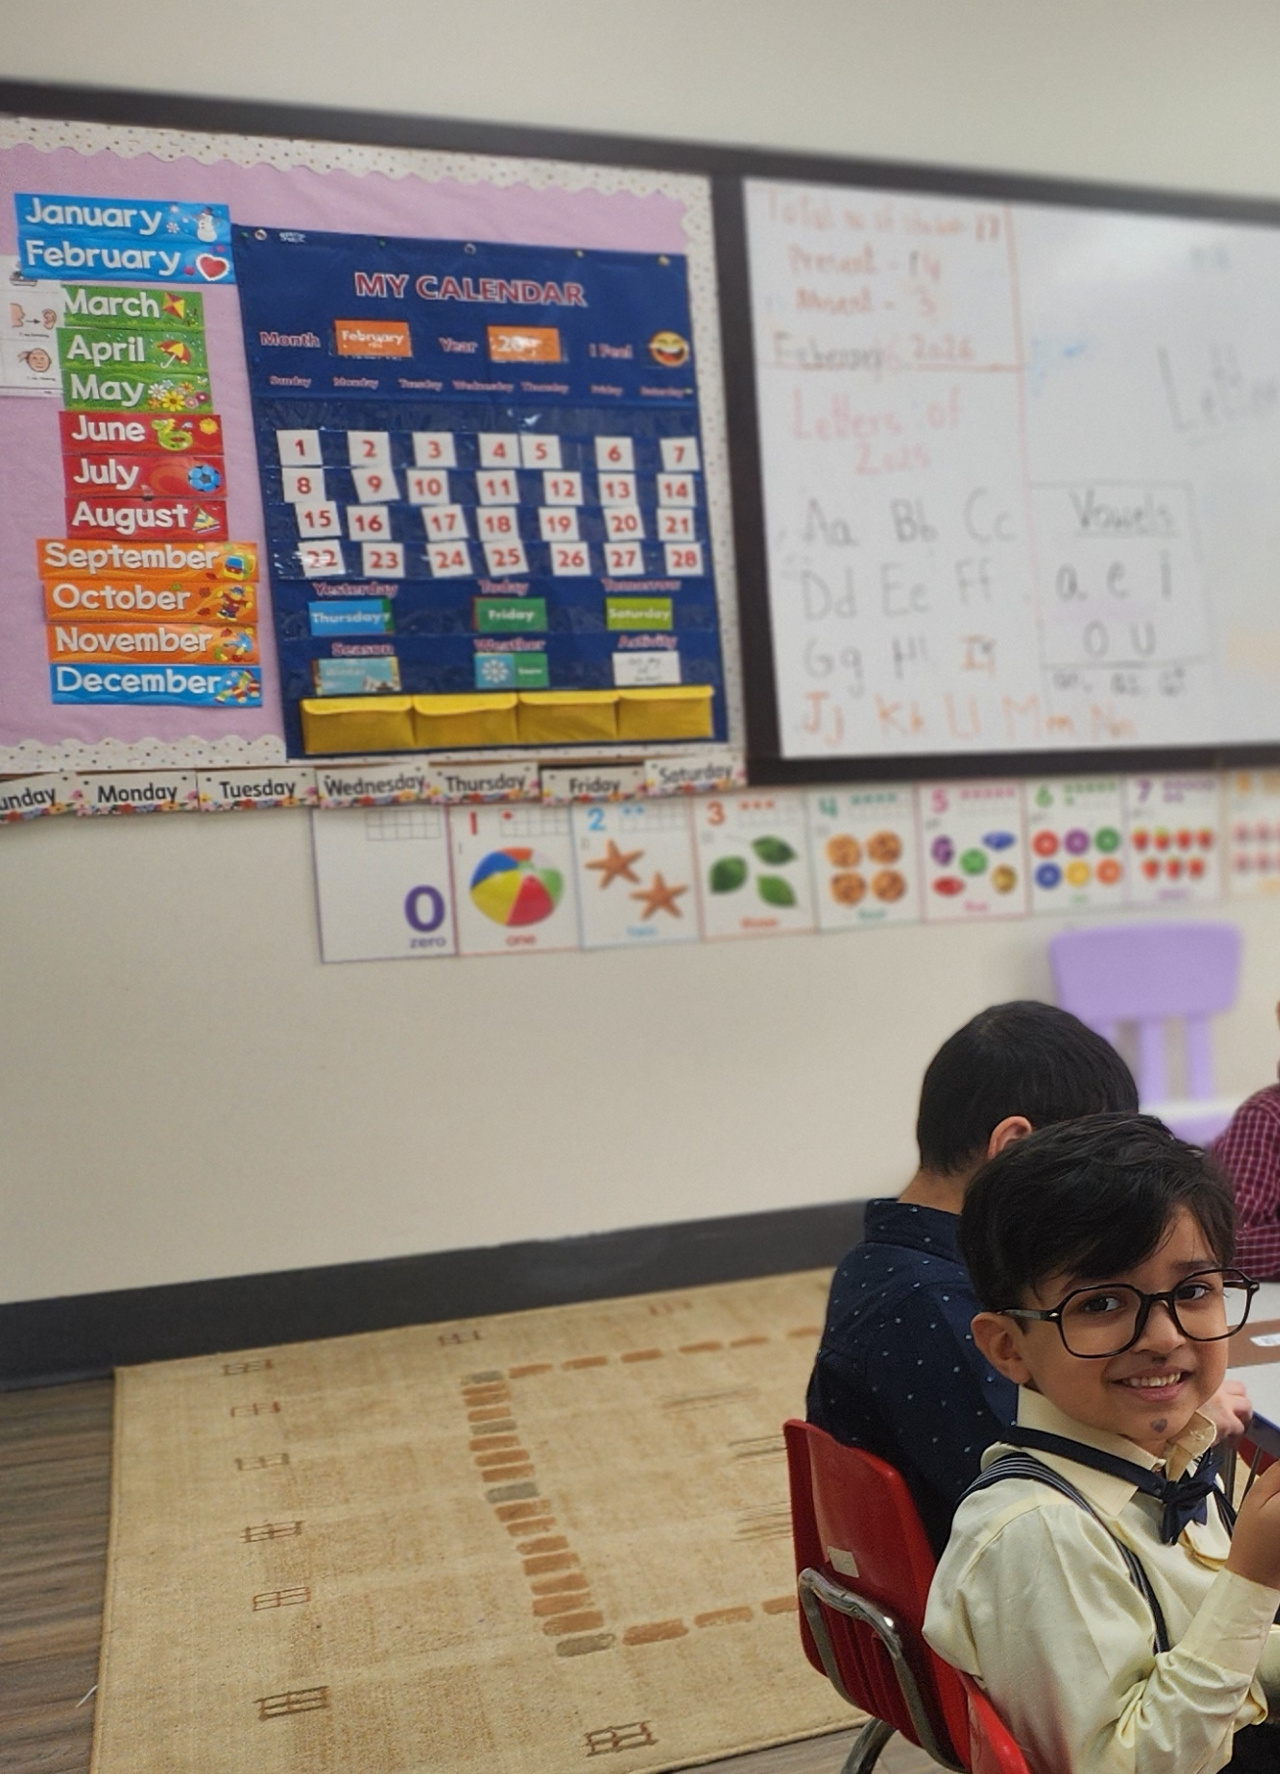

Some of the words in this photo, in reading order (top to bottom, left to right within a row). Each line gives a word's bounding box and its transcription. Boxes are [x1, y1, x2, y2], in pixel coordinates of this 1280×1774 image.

[26, 197, 162, 236] January
[26, 240, 181, 276] February
[354, 271, 408, 297] MY
[416, 275, 588, 307] CALENDAR
[64, 289, 160, 319] March
[259, 332, 321, 348] Month
[341, 330, 404, 346] February
[439, 337, 479, 353] Year
[67, 336, 145, 367] April
[71, 374, 144, 407] May
[71, 415, 146, 442] June
[294, 440, 305, 456] 1
[362, 440, 376, 457] 2
[428, 441, 441, 458] 3
[492, 442, 507, 458] 4
[534, 442, 547, 460] 5
[608, 445, 622, 462] 6
[673, 446, 686, 463] 7
[72, 458, 140, 491] July
[296, 476, 311, 494] 8
[368, 475, 382, 493] 9
[414, 478, 441, 496] 10
[485, 479, 510, 496] 11
[550, 480, 576, 498] 12
[605, 481, 630, 499] 13
[664, 482, 688, 499] 14
[71, 501, 188, 535] August
[304, 509, 331, 528] 15
[355, 514, 383, 532] 16
[431, 514, 456, 532] 17
[485, 516, 510, 533] 18
[547, 515, 571, 533] 19
[610, 515, 637, 532] 20
[664, 517, 689, 533] 21
[44, 543, 219, 574] September
[307, 549, 338, 569] 22
[369, 551, 399, 569] 23
[435, 550, 464, 569] 24
[493, 548, 520, 567] 25
[557, 551, 584, 568] 26
[610, 551, 636, 568] 27
[671, 550, 697, 568] 28
[52, 584, 191, 610] October
[313, 581, 398, 599] Yesterday
[477, 578, 530, 597] Today
[312, 611, 381, 625] Thursday
[488, 609, 535, 622] Friday
[608, 607, 670, 621] Saturday
[55, 626, 213, 653] November
[331, 642, 395, 657] Season
[56, 667, 222, 694] December
[97, 785, 178, 805] Monday
[219, 780, 296, 801] Tuesday
[323, 773, 425, 797] Wednesday
[445, 773, 526, 794] Thursday
[569, 777, 620, 794] Friday
[659, 763, 732, 785] Saturday
[586, 808, 606, 831] 2
[706, 802, 726, 826] 3
[404, 885, 445, 932] 0
